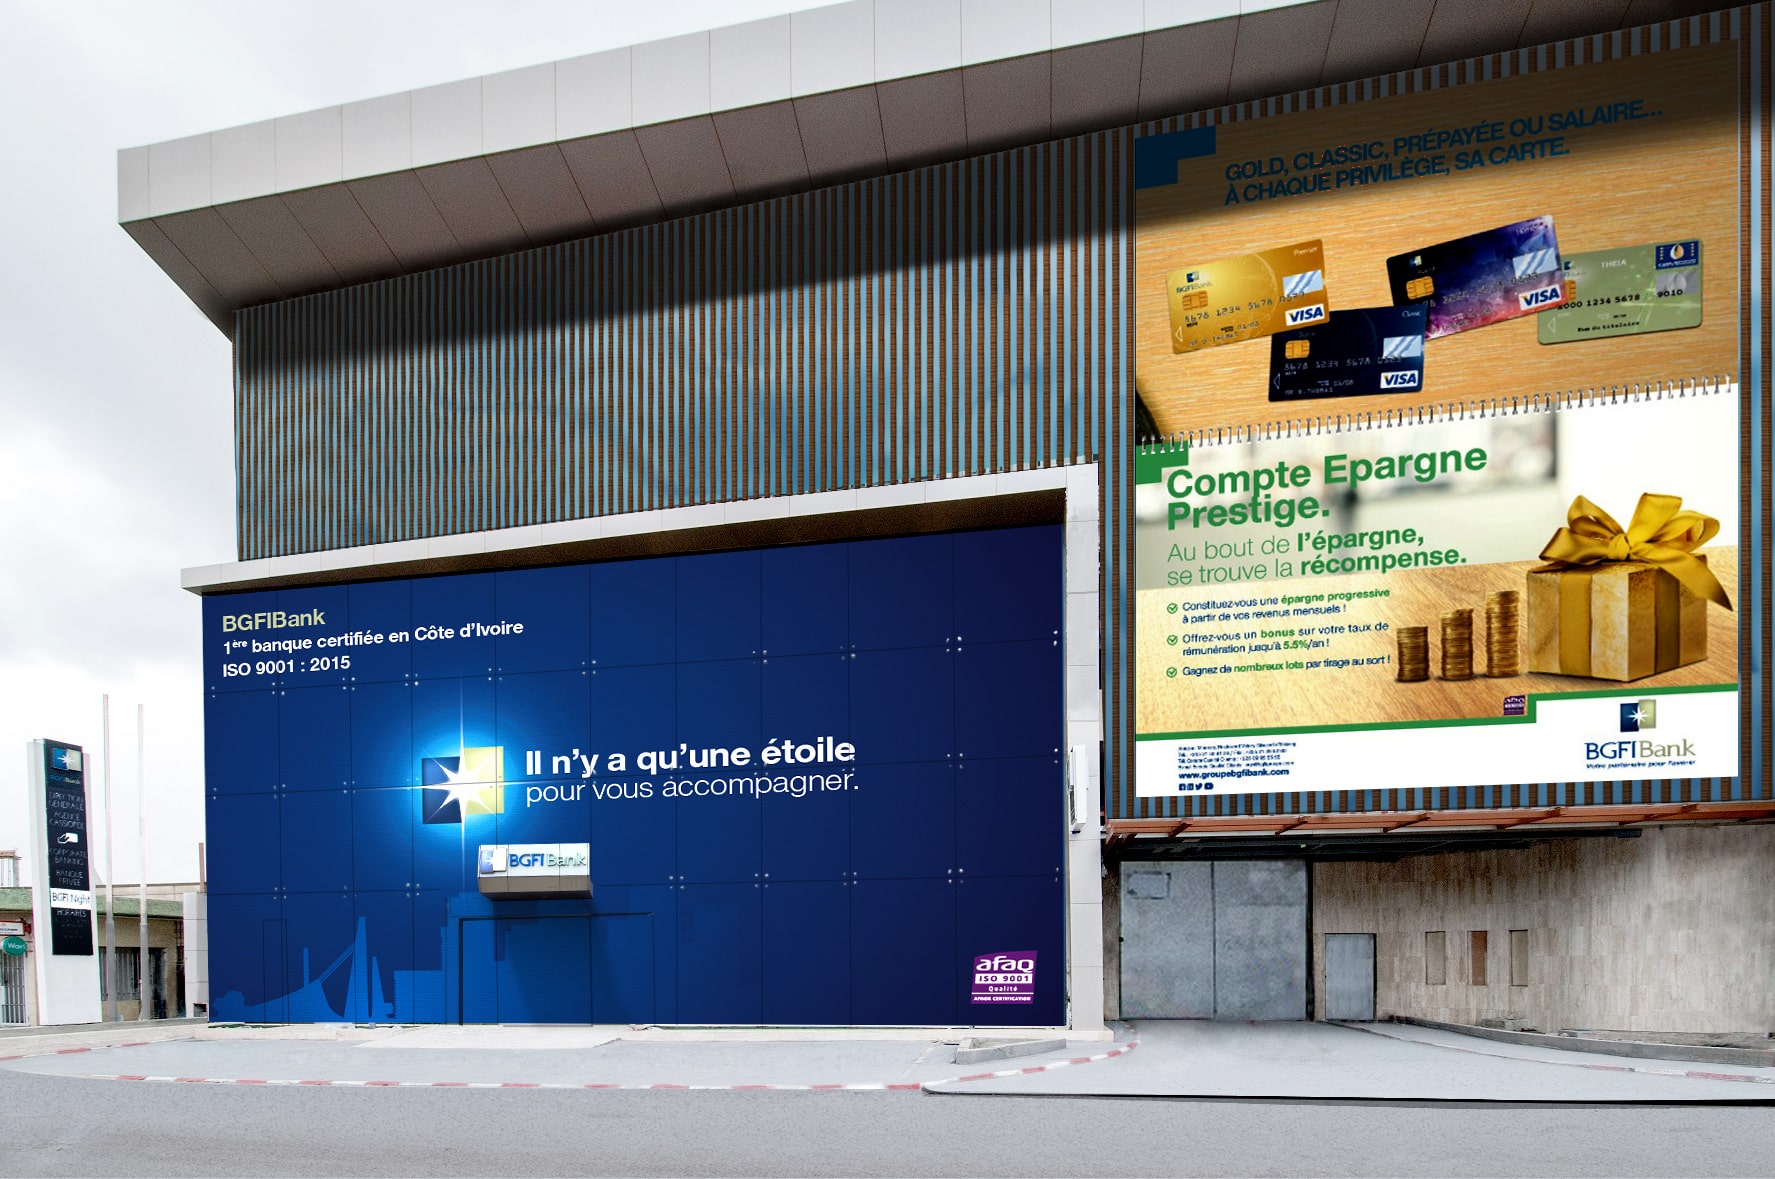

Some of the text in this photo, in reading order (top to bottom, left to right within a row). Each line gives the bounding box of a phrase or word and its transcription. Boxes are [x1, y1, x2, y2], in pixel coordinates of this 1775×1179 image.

[1225, 158, 1288, 181] GOLD,
[1293, 142, 1388, 174] CLASSIC,
[1393, 120, 1504, 156] PRÉPAYÉE
[1509, 114, 1543, 137] OU
[1224, 136, 1570, 206] À CHAQUE PRIVILÈGE, SA CARTE.
[1524, 288, 1560, 306] VISA
[1586, 298, 1612, 306] 1234
[1615, 294, 1640, 303] 5678
[1657, 289, 1683, 298] 9010
[1288, 306, 1323, 322] VISA
[1383, 372, 1416, 386] VISA
[1166, 448, 1488, 500] Compte Epargne
[1166, 494, 1330, 530] Prestige.
[1167, 528, 1424, 562] Au bout de l’épargne,
[1167, 548, 1467, 586] se trouve la récompense.
[1182, 588, 1390, 612] Constituez-vous une épargne progressive
[222, 608, 326, 632] BGFIBank
[1190, 613, 1216, 625] partir
[1218, 612, 1231, 622] de
[1233, 612, 1250, 621] vos
[1252, 608, 1290, 620] revenus
[1293, 604, 1340, 617] mensuels
[252, 637, 312, 655] banque
[316, 630, 384, 649] certifiée
[388, 630, 410, 644] en
[414, 624, 454, 642] Côte
[1182, 621, 1389, 644] Offrez-vous un bonus sur votre taux de
[1182, 644, 1246, 656] rémunération
[222, 656, 350, 678] ISO 9001 : 2015
[1182, 666, 1218, 678] Gagnez
[1220, 664, 1232, 674] de
[1234, 661, 1284, 673] nombreux
[1286, 660, 1304, 670] lots
[1306, 660, 1322, 671] par
[1323, 657, 1350, 669] tirage
[1352, 658, 1364, 666] au
[1366, 656, 1386, 666] sort
[525, 736, 857, 779] Il n’y a qu’une étoile
[1179, 768, 1290, 780] www.groupebgfibank.com
[526, 770, 860, 808] pour vous accompagner.
